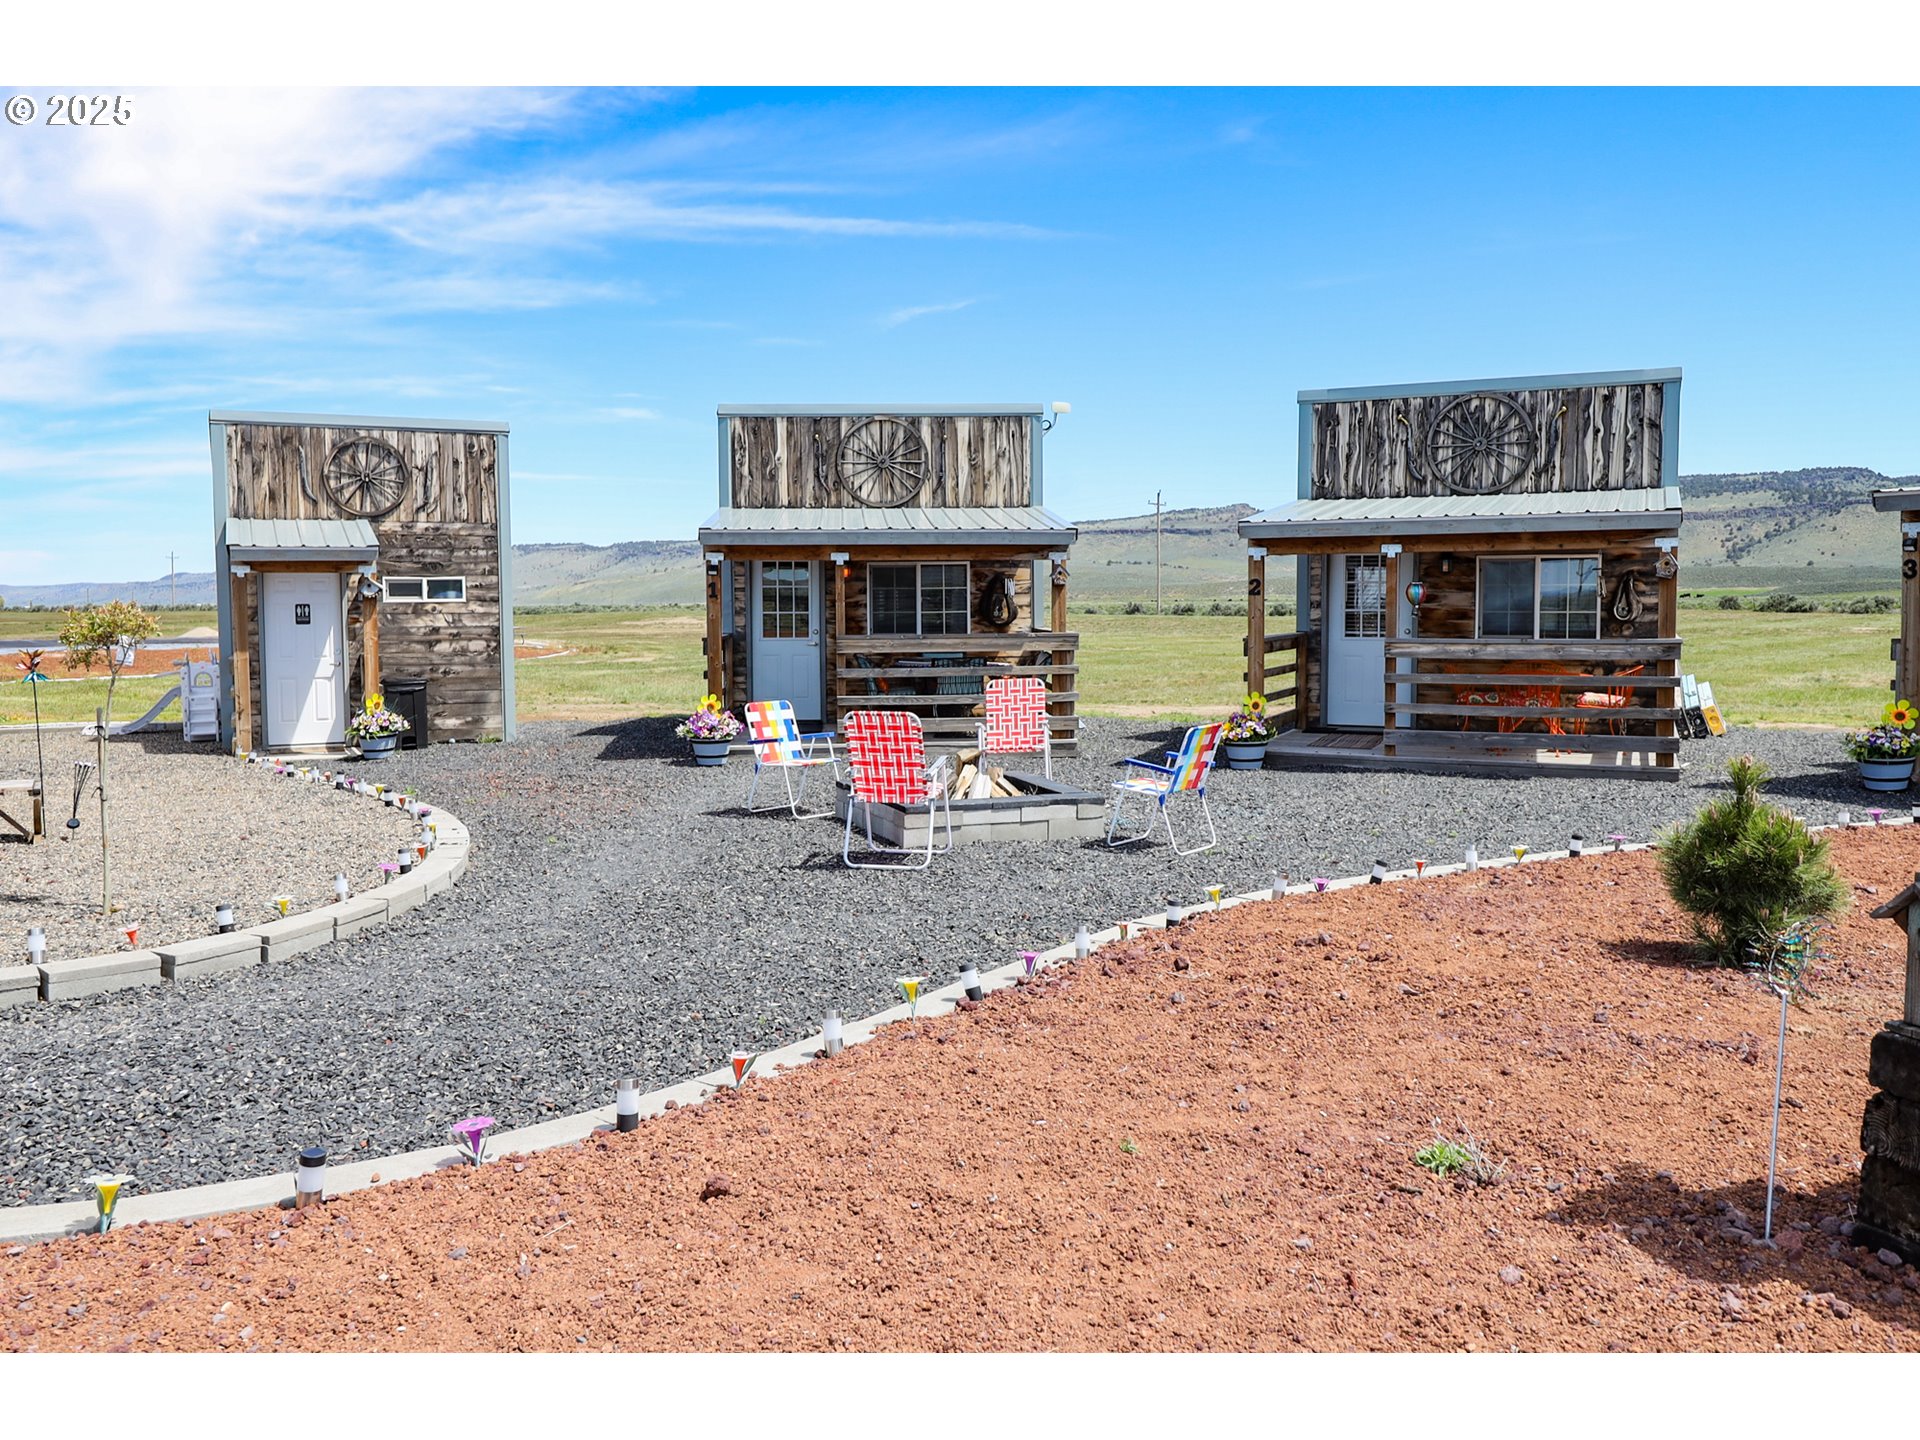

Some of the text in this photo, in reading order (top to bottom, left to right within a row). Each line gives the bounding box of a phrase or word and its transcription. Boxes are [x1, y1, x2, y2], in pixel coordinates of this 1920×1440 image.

[1902, 558, 1918, 580] 3
[708, 582, 718, 600] 1
[1248, 578, 1262, 596] 2
